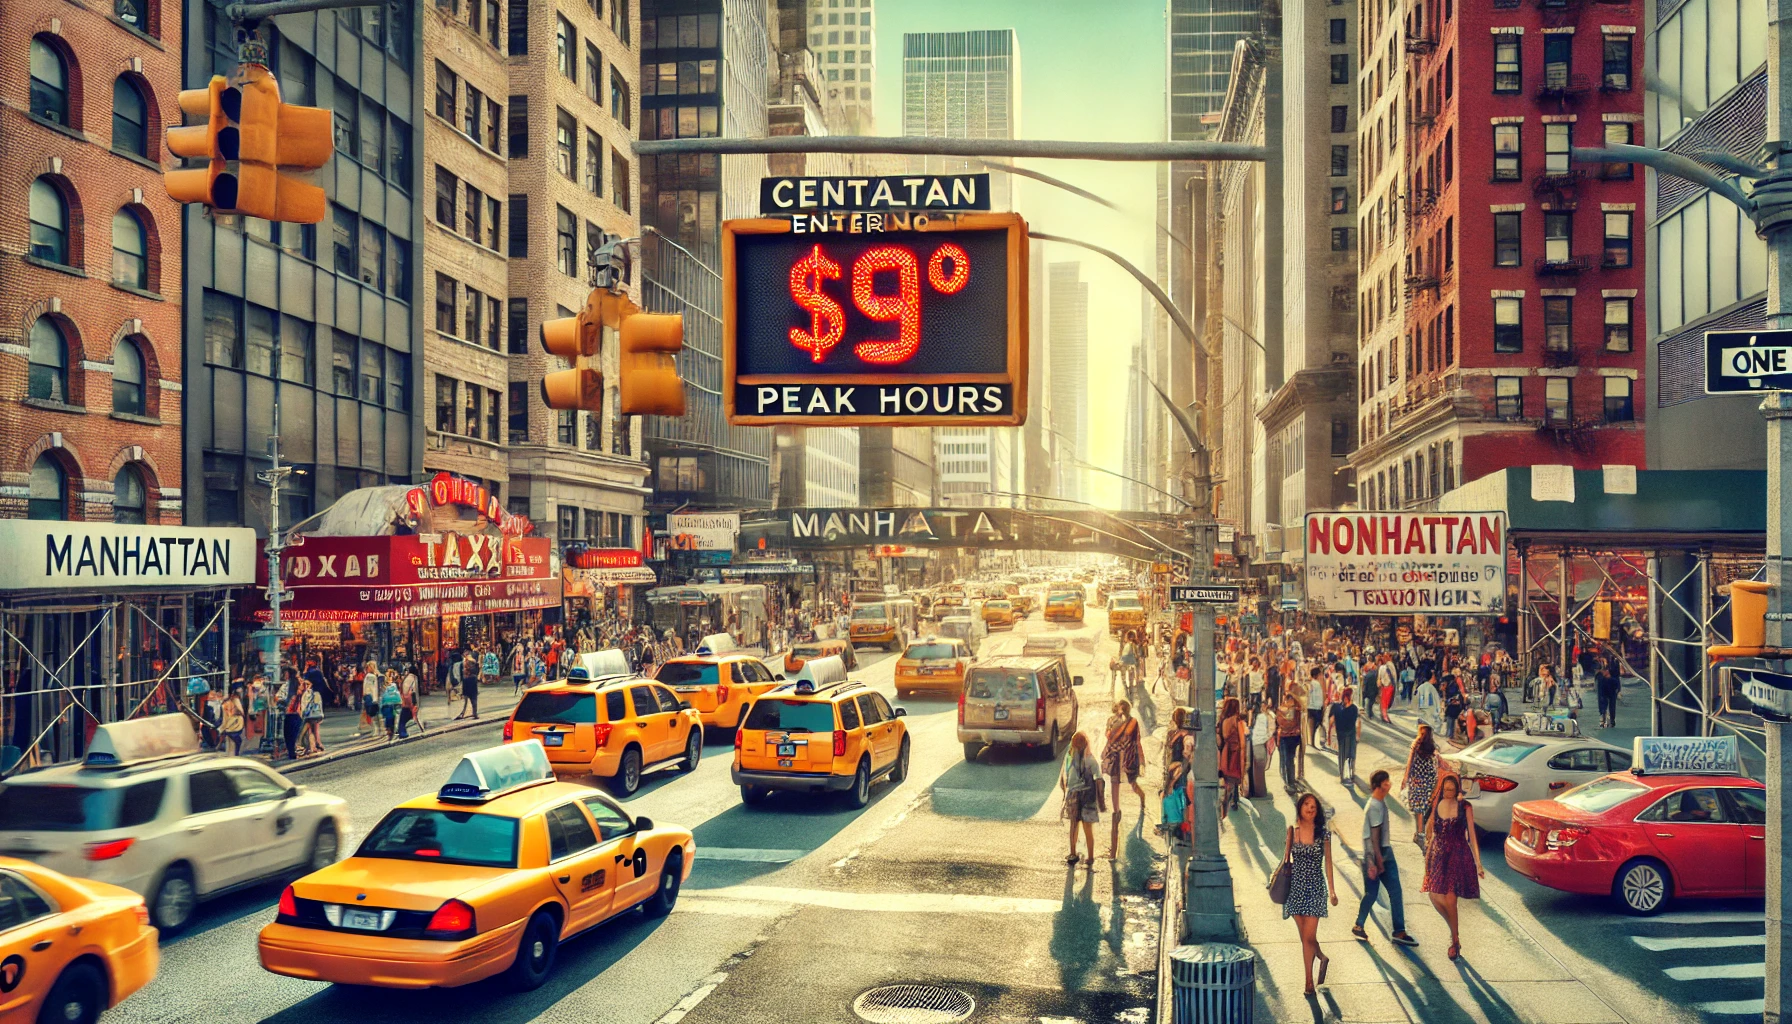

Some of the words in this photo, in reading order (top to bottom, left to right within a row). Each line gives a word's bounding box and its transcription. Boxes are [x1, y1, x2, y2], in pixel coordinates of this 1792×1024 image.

[1732, 349, 1787, 374] ONE
[757, 386, 856, 414] PEAK
[879, 386, 1003, 414] HOURS
[1308, 515, 1501, 556] NONHATTAN
[46, 534, 230, 576] MANHATTAN
